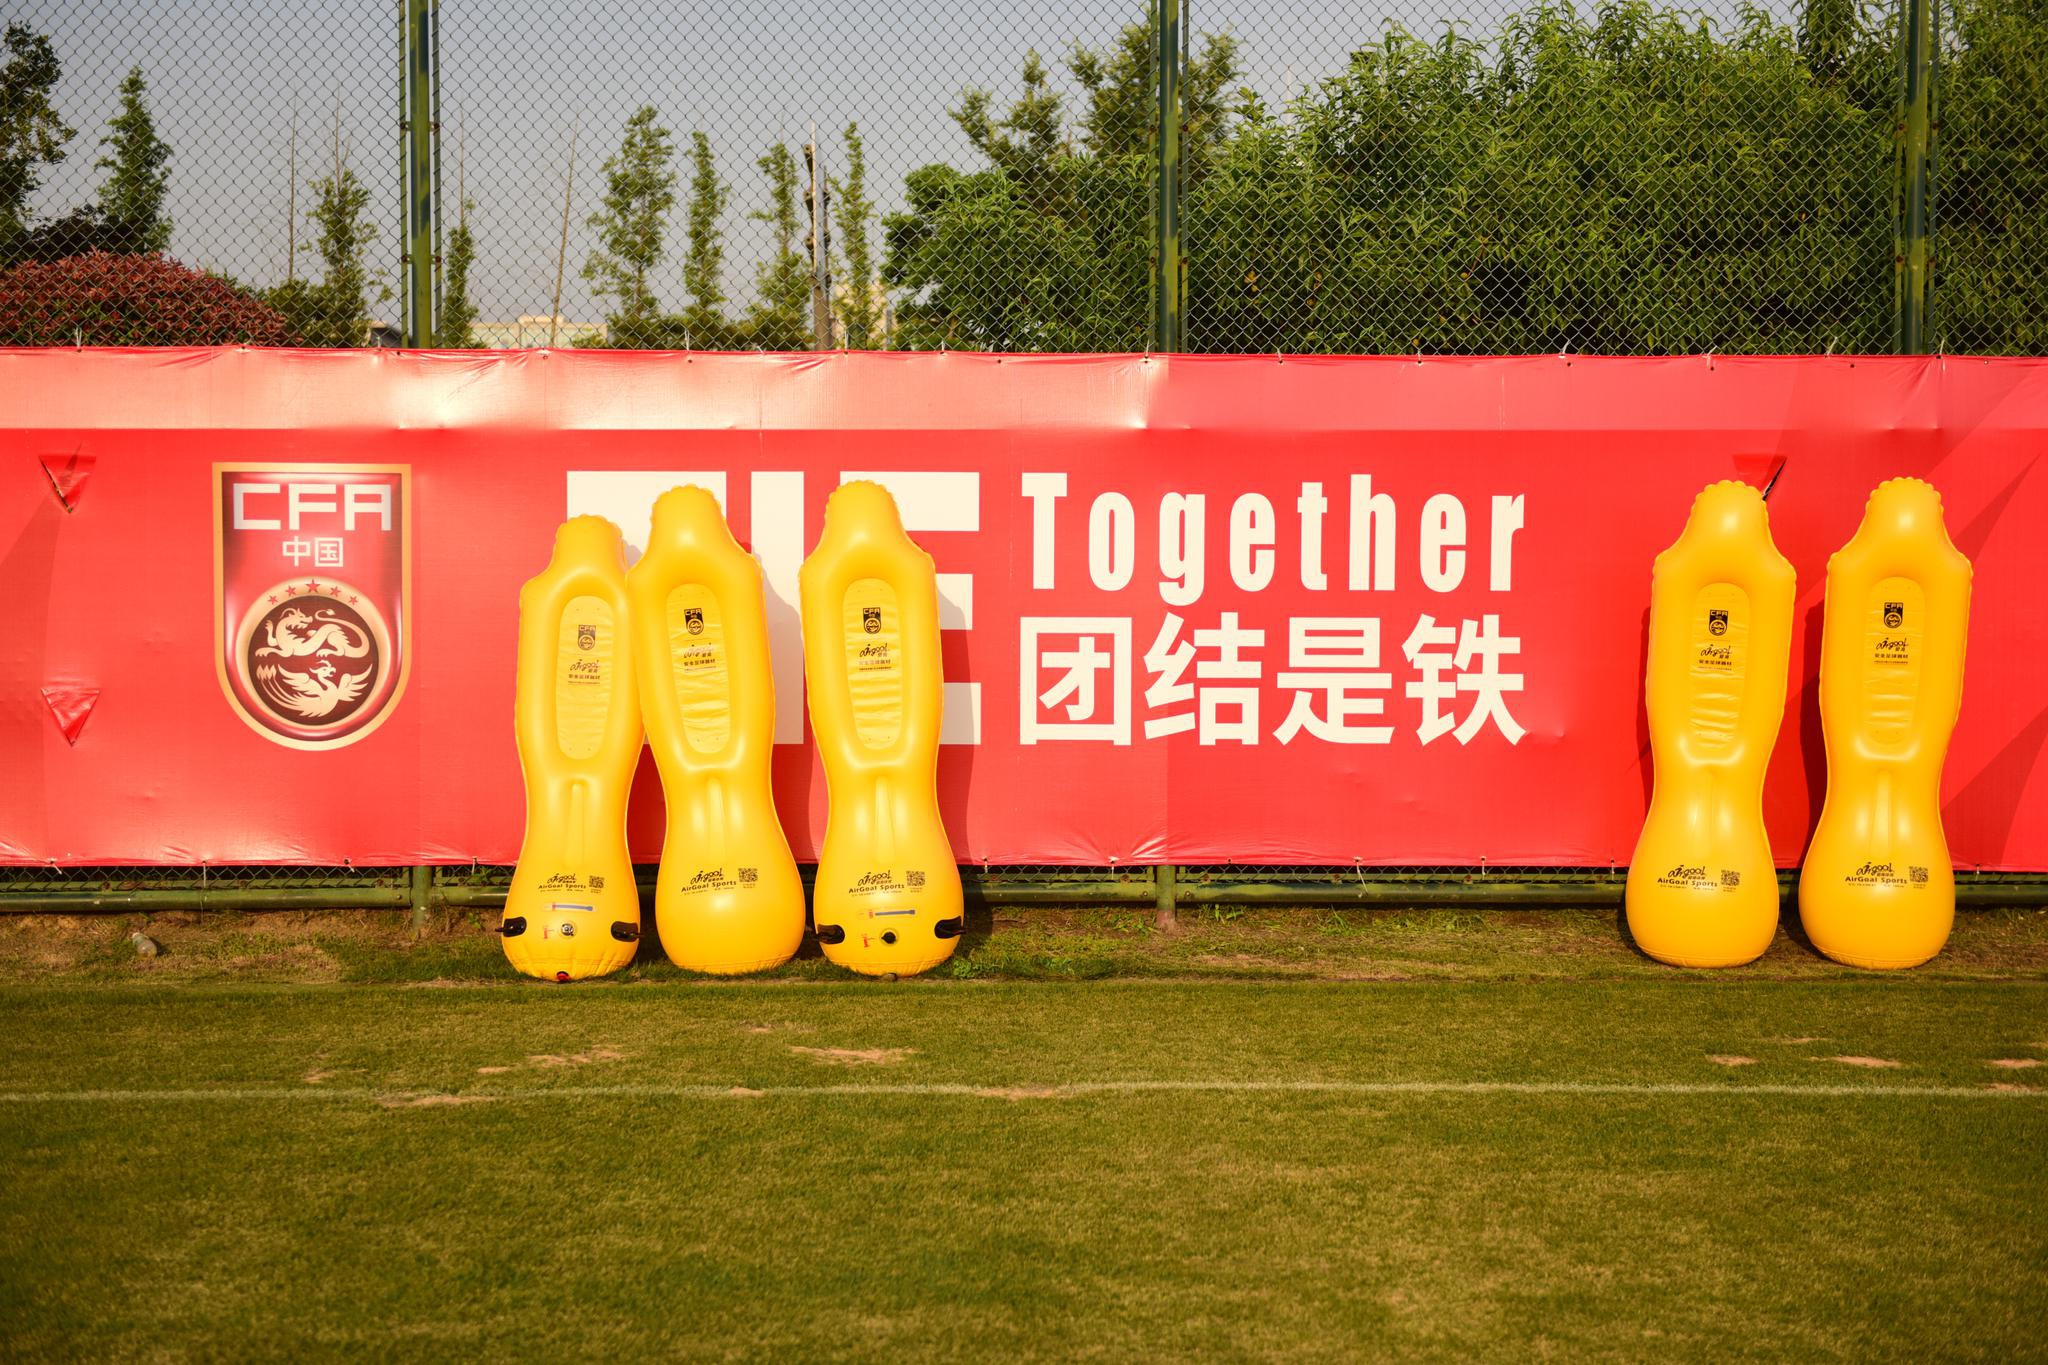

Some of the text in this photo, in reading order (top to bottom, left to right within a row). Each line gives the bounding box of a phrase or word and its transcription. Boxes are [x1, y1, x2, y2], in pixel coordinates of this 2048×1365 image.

[233, 483, 392, 531] CFA
[282, 536, 344, 567] 中国
[1021, 472, 1525, 607] Together
[1020, 612, 1526, 746] 团结是铁
[681, 883, 709, 892] AirGoal
[711, 880, 737, 888] Sports
[848, 886, 877, 894] AirGoal
